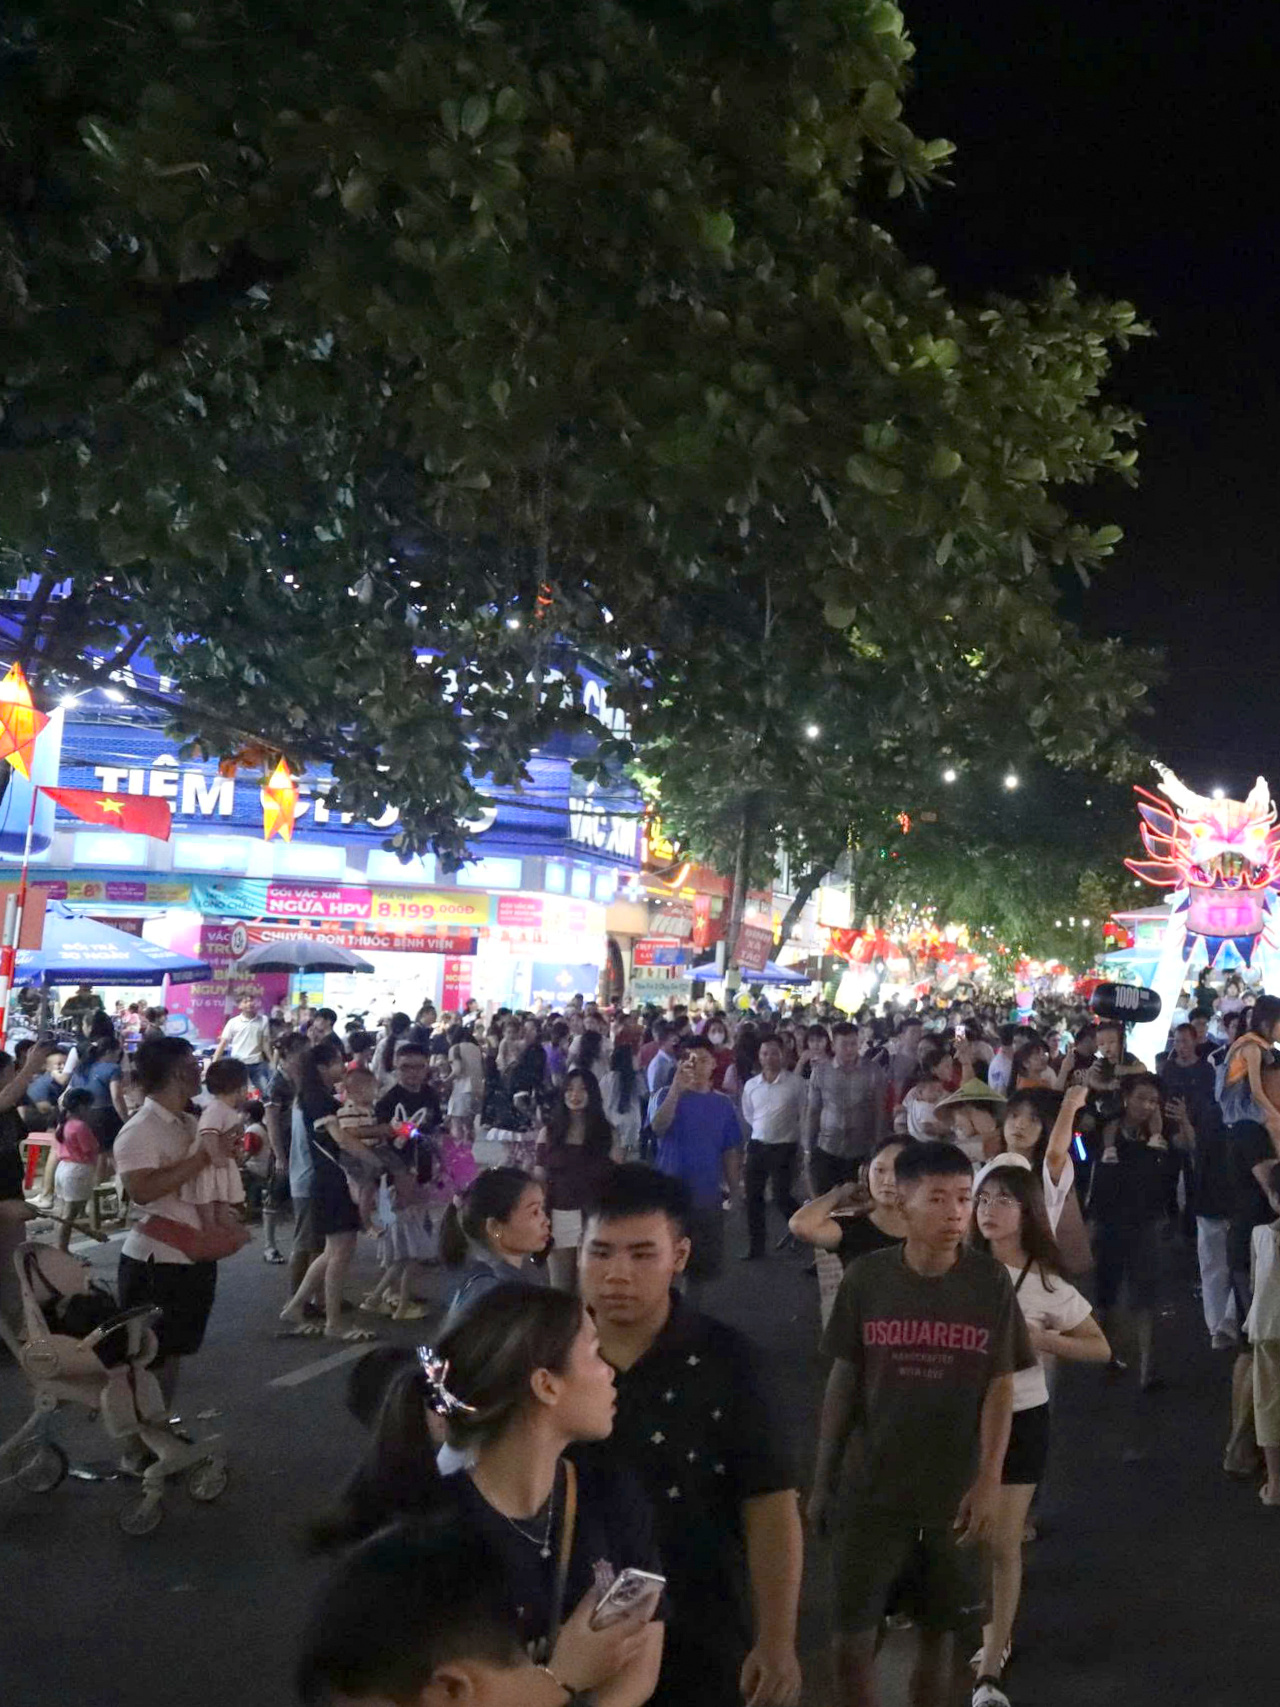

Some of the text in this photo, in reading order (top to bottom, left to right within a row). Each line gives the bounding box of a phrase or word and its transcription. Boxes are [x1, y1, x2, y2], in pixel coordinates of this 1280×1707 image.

[94, 754, 235, 815] TIÊM
[271, 888, 292, 897] GÓI
[321, 891, 341, 899] XIN
[269, 899, 369, 915] NGỪA HPV
[863, 1318, 990, 1355] DSQUARED2
